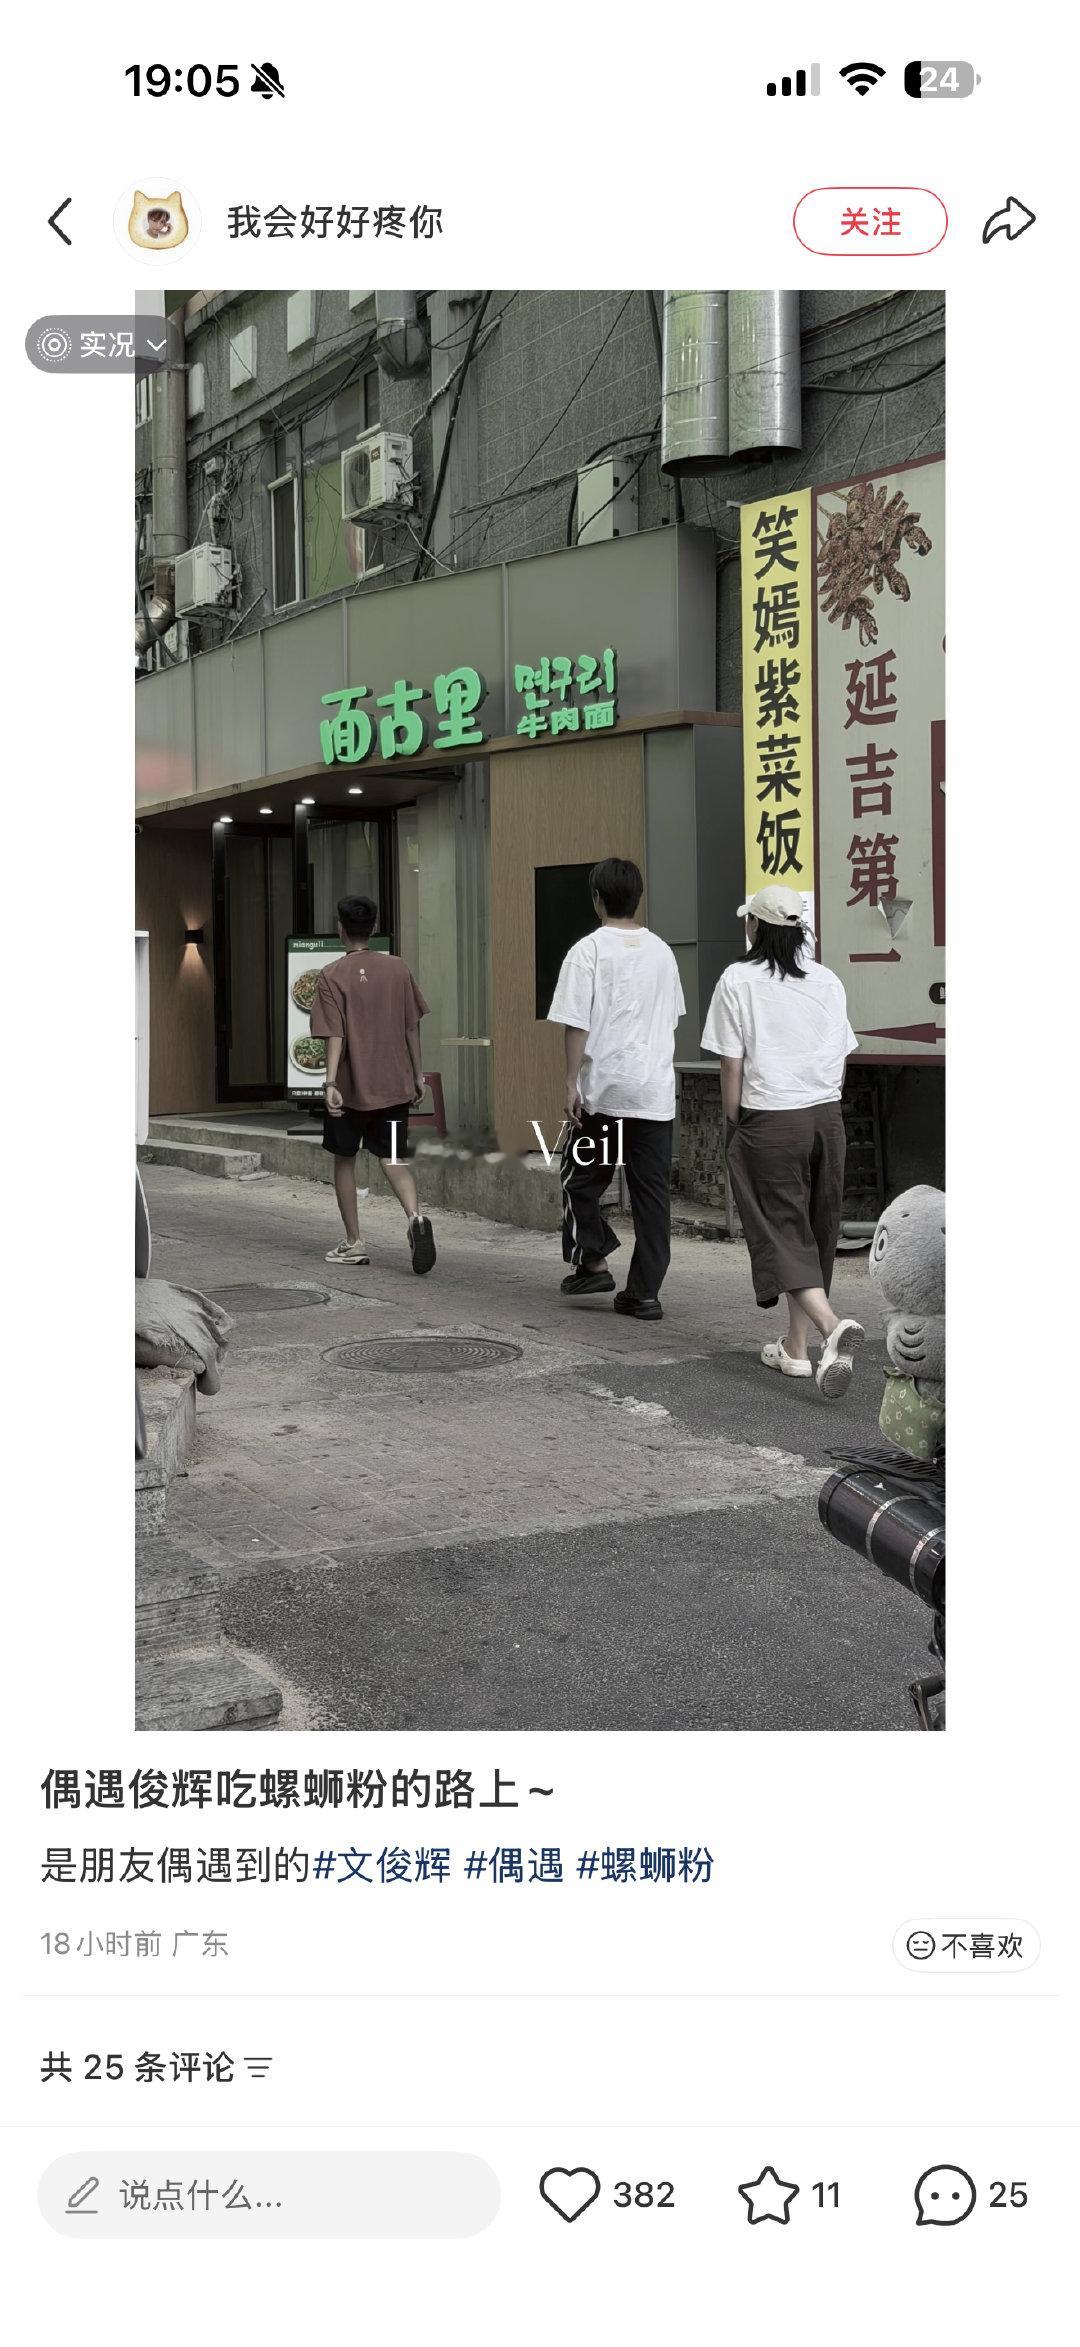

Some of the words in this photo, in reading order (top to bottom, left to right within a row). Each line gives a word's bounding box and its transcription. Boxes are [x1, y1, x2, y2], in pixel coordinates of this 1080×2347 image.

[124, 63, 240, 98] 19:05
[919, 66, 960, 92] 24
[227, 202, 444, 241] 我会好好疼你
[840, 206, 902, 237] 关注
[80, 330, 136, 358] 实况
[514, 648, 615, 710] 면구리
[751, 504, 804, 877] 笑嫣紫菜饭
[516, 700, 615, 739] 牛肉面
[843, 648, 902, 963] 延吉第一
[463, 1846, 564, 1884] #偶遇
[575, 1845, 715, 1884] #螺蛳粉
[172, 1929, 230, 1958] 广东
[940, 1931, 1025, 1960] 不喜欢
[84, 2053, 124, 2081] 25
[134, 2050, 235, 2083] 条评论
[613, 2180, 676, 2209] 382
[811, 2181, 841, 2208] 11
[989, 2180, 1028, 2209] 25
